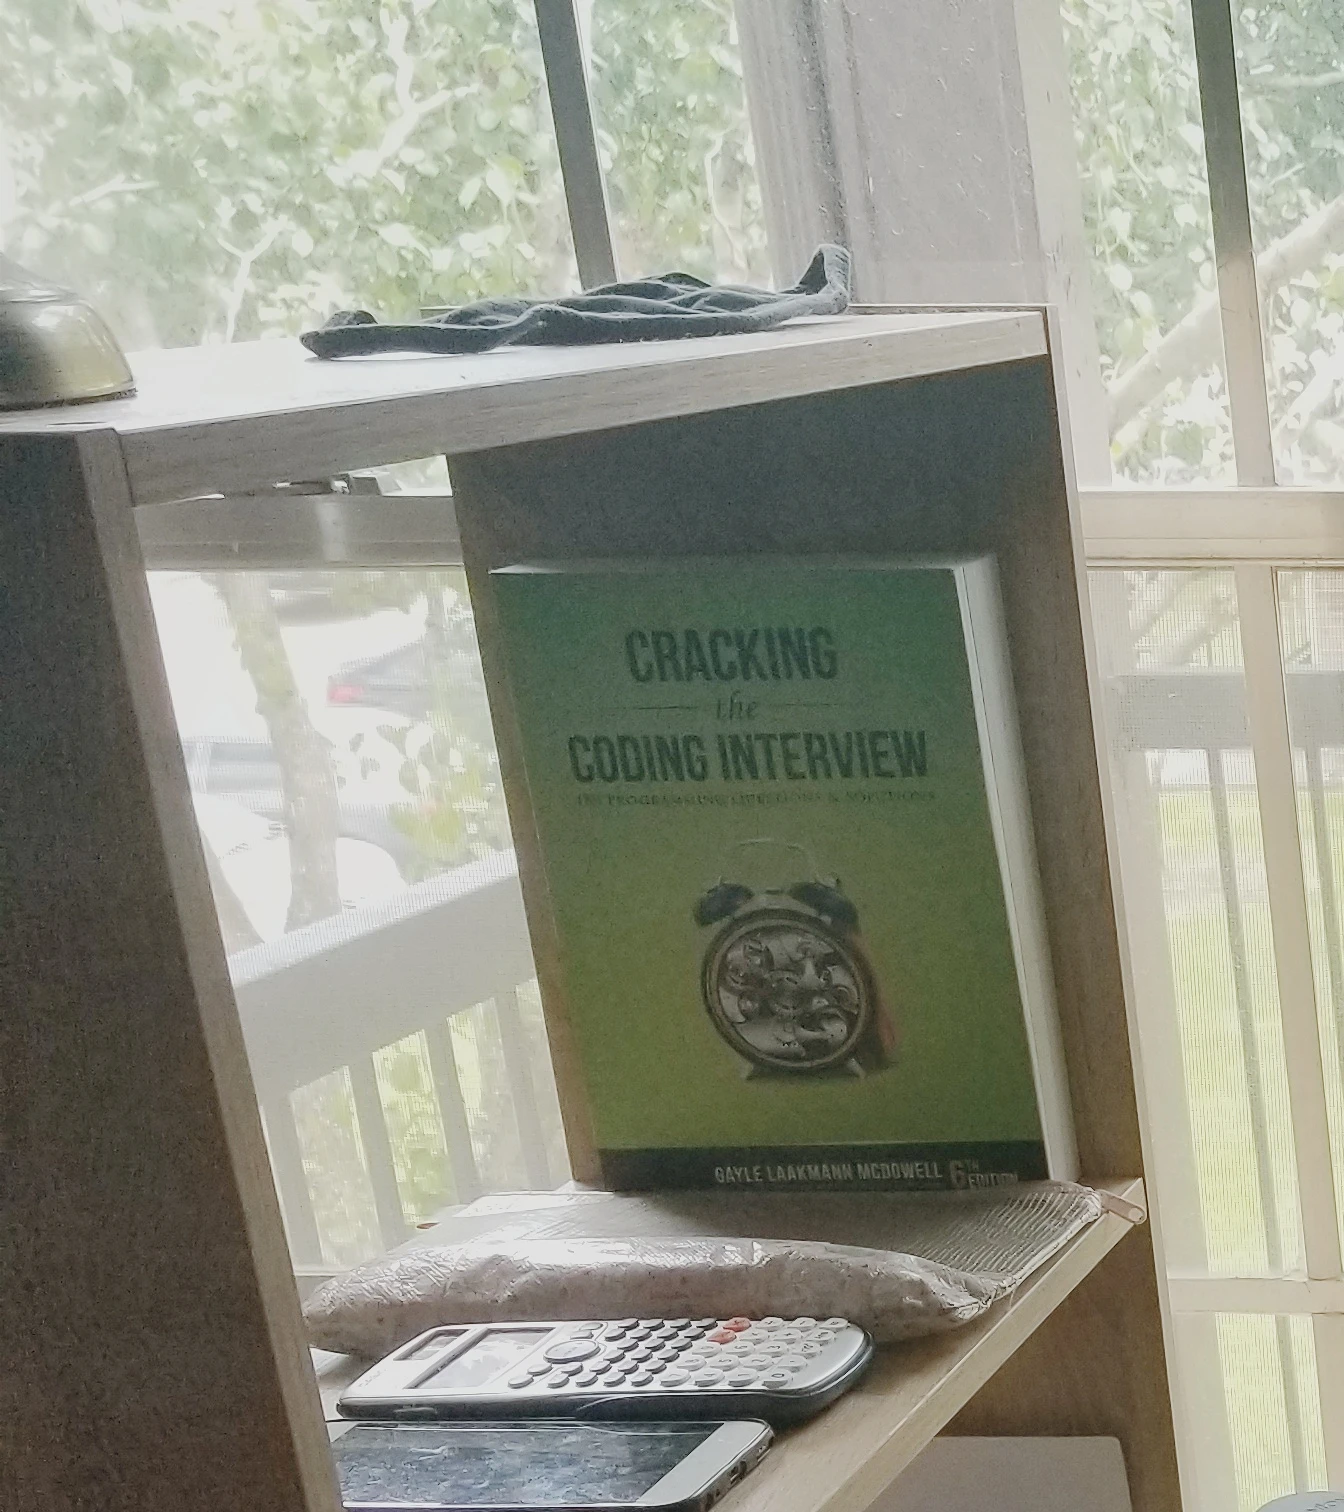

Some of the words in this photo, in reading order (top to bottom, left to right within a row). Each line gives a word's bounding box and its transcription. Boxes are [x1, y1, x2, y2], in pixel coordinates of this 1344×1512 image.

[624, 626, 838, 682] CRACKING
[715, 689, 758, 721] the
[568, 734, 709, 783] CODING
[716, 729, 928, 781] INTERVIEW
[714, 1166, 762, 1183] GAYLE
[766, 1164, 852, 1182] LAAKMANN
[857, 1162, 943, 1180] MCDOWELL
